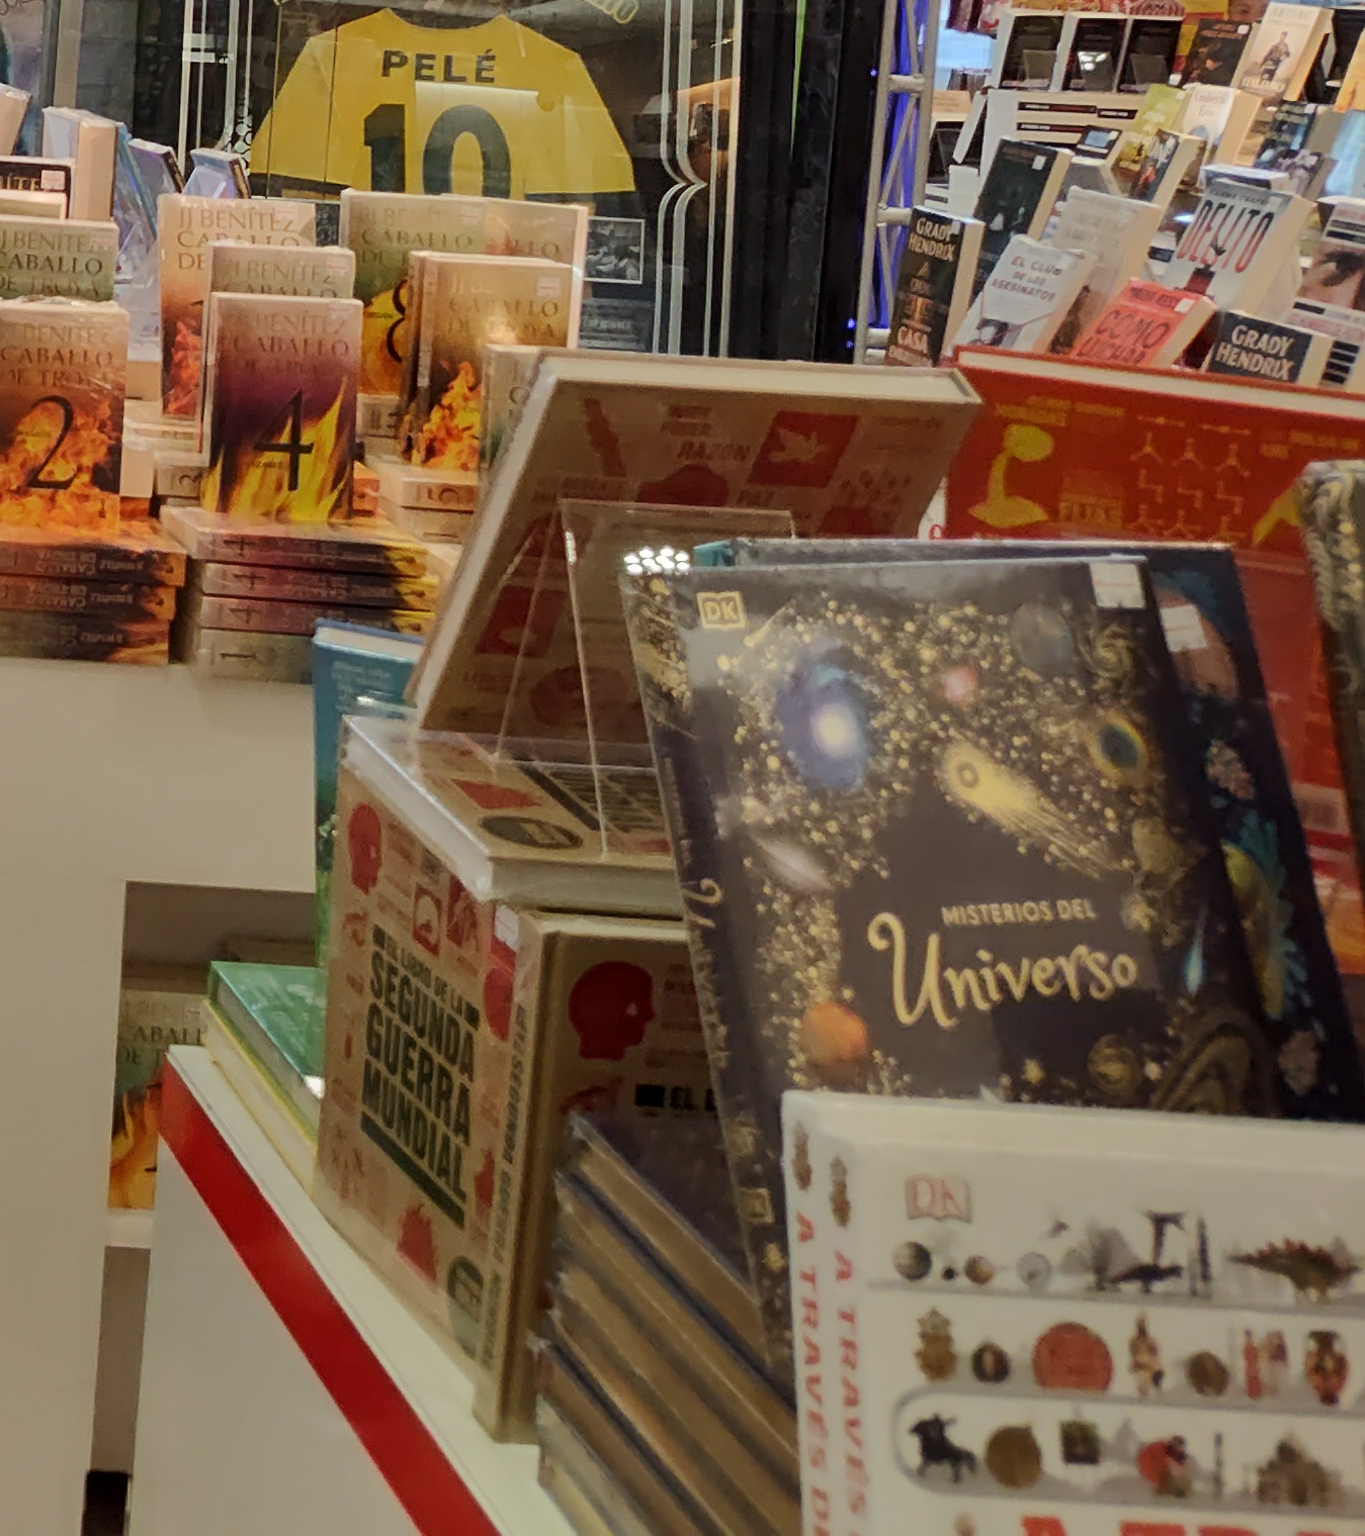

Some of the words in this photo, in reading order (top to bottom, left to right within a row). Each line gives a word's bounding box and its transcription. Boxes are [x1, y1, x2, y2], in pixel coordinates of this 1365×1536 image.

[381, 48, 497, 84] PELÉ
[362, 103, 511, 200] 10
[199, 206, 299, 233] BENÍTEZ
[915, 217, 953, 242] GRADY
[1175, 196, 1276, 275] DELITO
[13, 229, 93, 254] BENÍTE
[907, 232, 956, 262] HENDRIX
[1010, 255, 1026, 267] EL
[1030, 259, 1063, 277] CLUB
[0, 345, 115, 367] CABALLO
[895, 325, 930, 354] CASA
[1230, 324, 1295, 359] GRADY
[1214, 344, 1297, 383] HENDRIX
[17, 394, 72, 491] 2
[253, 387, 316, 494] 4
[704, 599, 739, 624] DK
[940, 899, 1053, 927] MISTERIOS
[1054, 898, 1098, 922] DEL
[867, 911, 1139, 1031] Universo
[368, 950, 477, 1085] SEGUNDA
[365, 1001, 473, 1150] GUERRA
[362, 1059, 469, 1204] MUNDIAL
[798, 1267, 832, 1472] TRAVÉS
[835, 1305, 867, 1520] TRAVÉS
